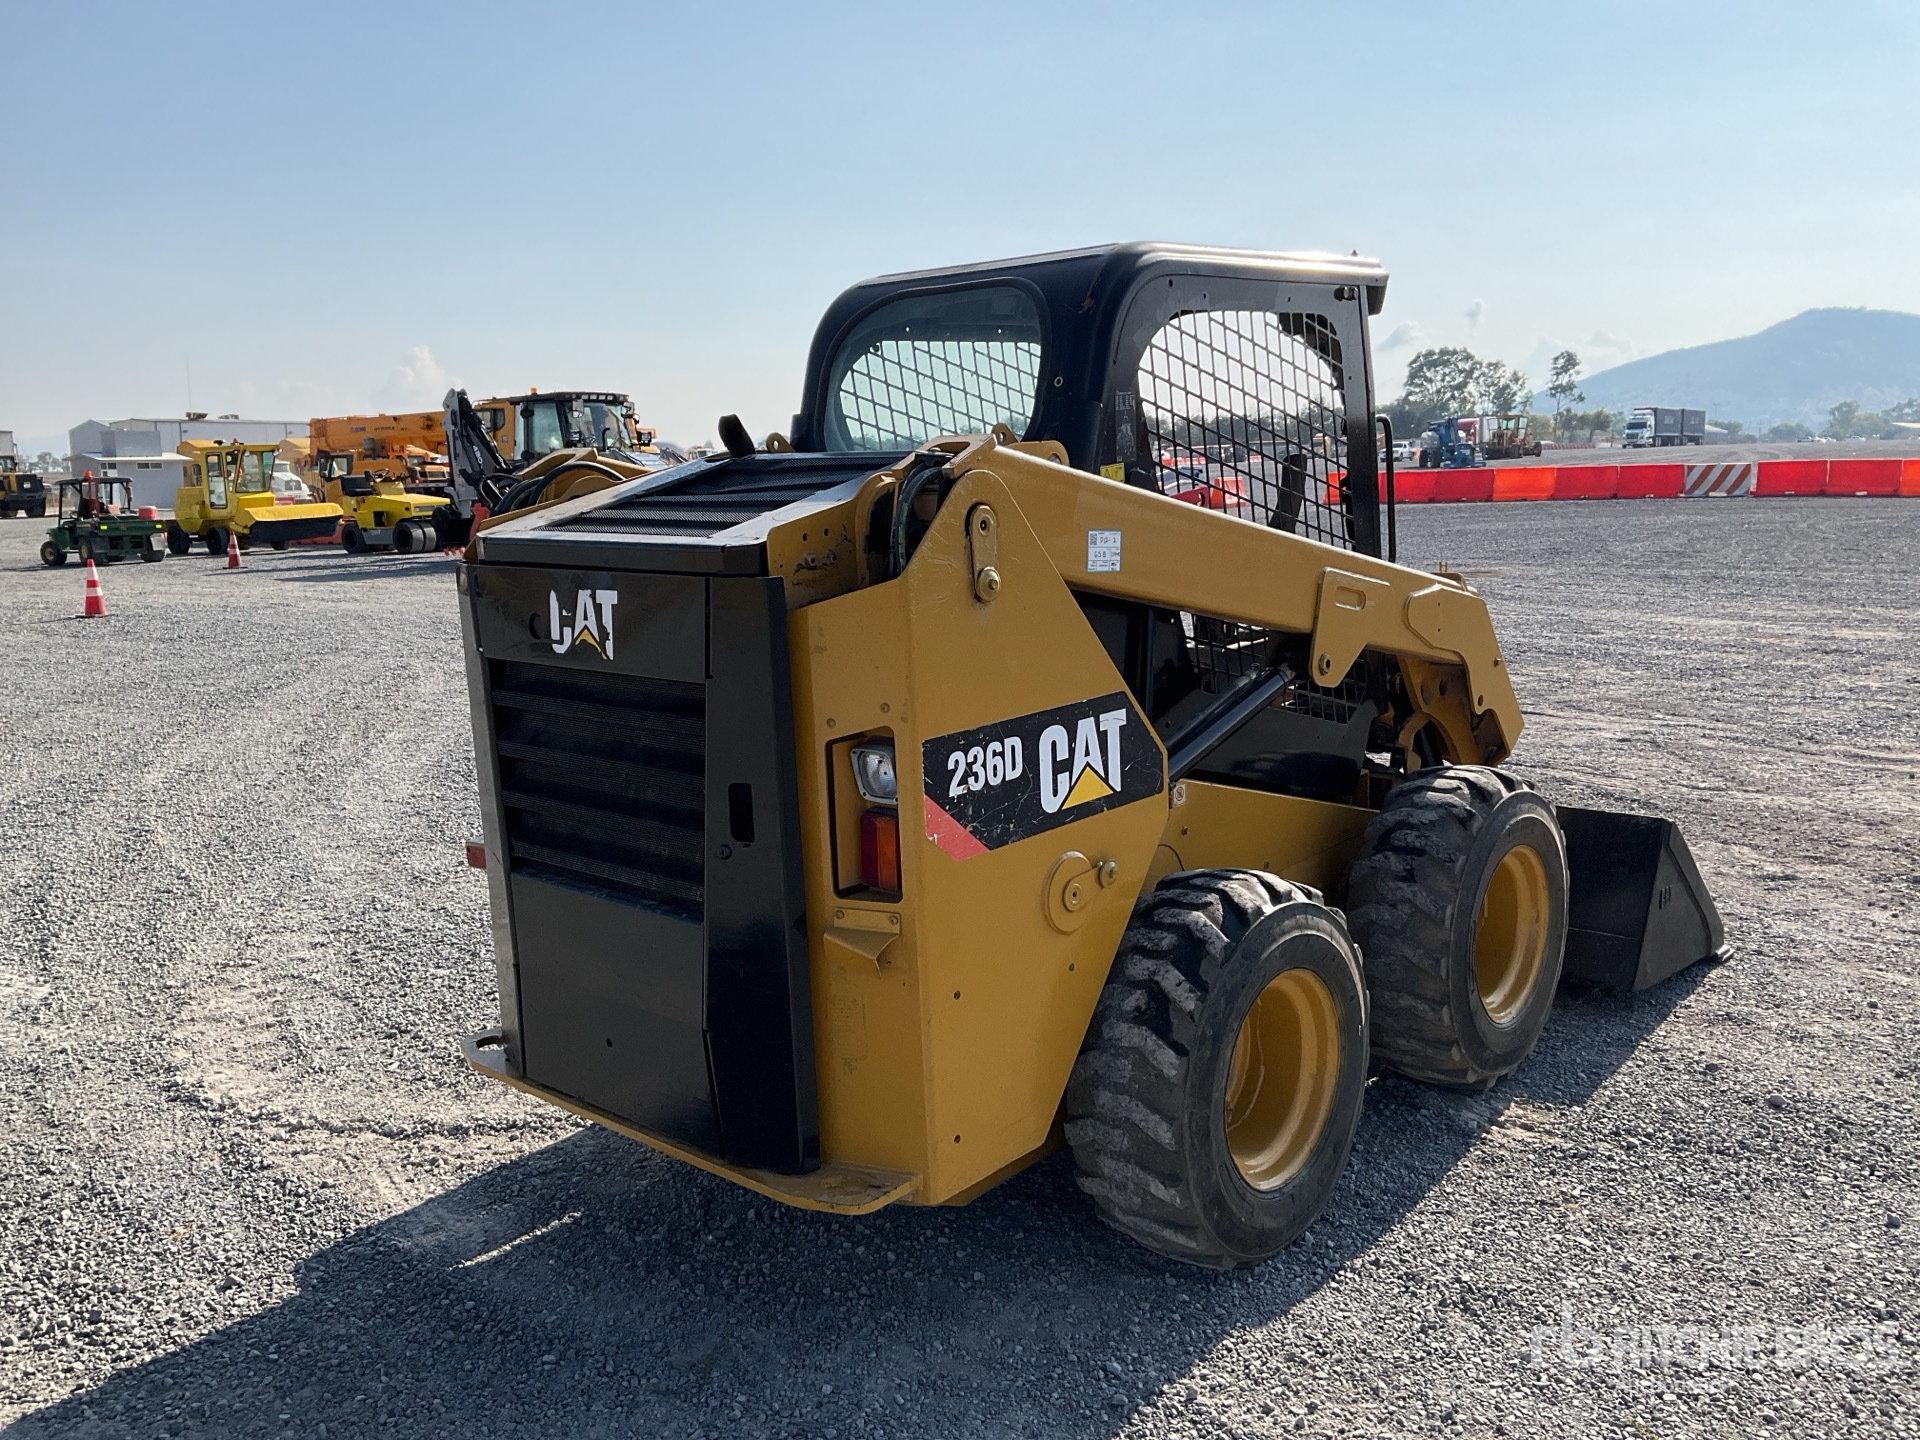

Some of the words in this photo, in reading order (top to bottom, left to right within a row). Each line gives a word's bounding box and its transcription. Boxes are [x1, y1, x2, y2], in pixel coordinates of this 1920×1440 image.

[549, 589, 618, 660] CAT
[947, 736, 1023, 798] 236D
[1038, 708, 1127, 814] CAT
